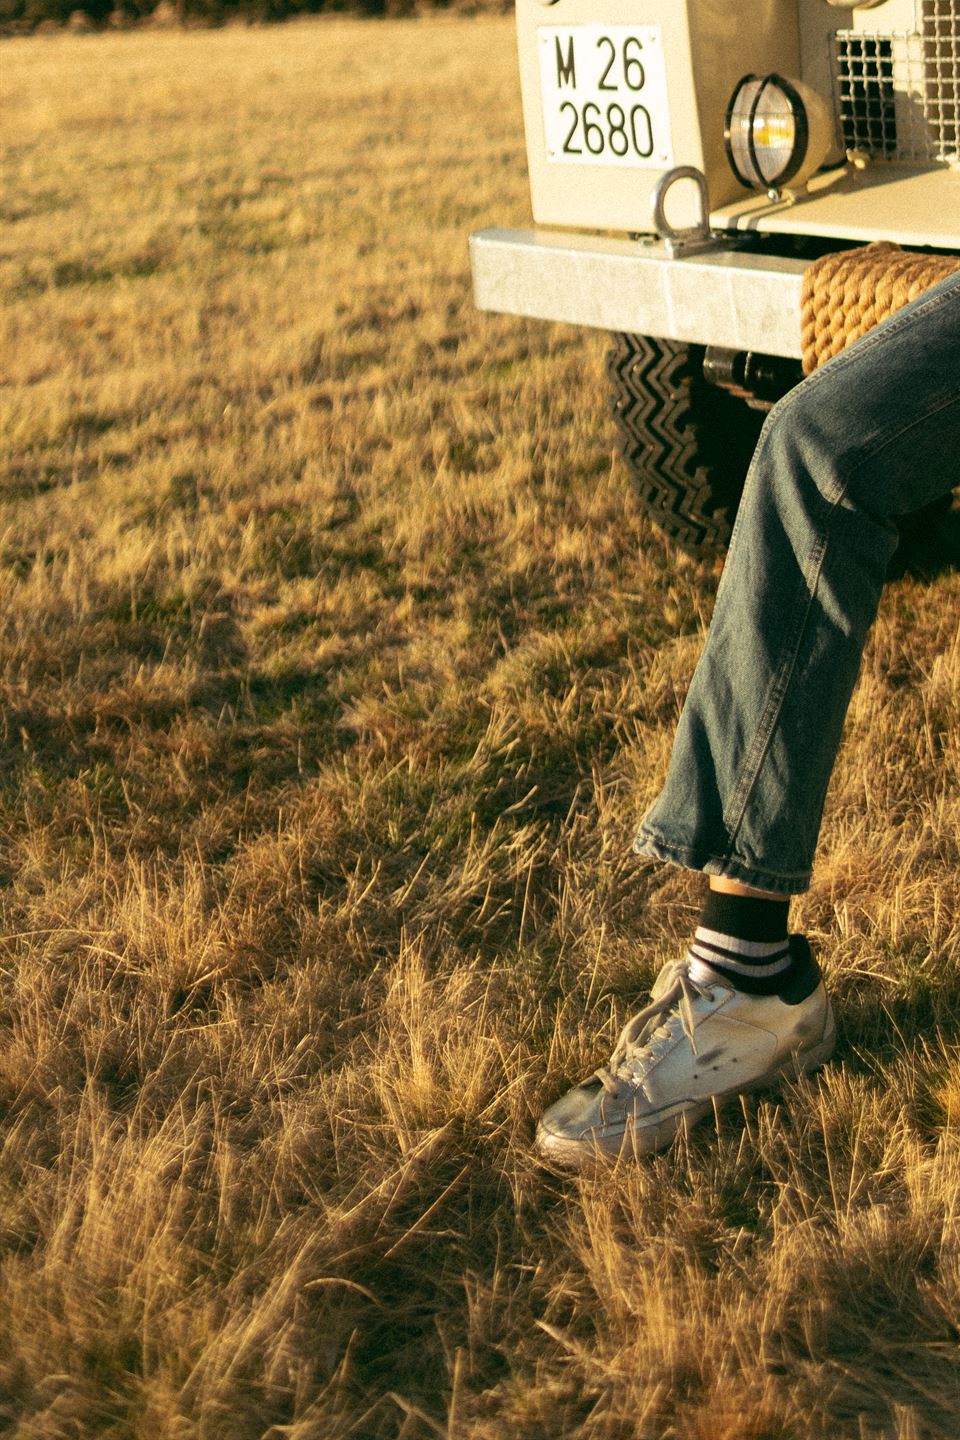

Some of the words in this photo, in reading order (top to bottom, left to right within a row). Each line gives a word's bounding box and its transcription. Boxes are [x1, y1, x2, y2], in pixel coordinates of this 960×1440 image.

[555, 35, 576, 90] M
[596, 36, 646, 91] 26
[560, 101, 654, 158] 2680
